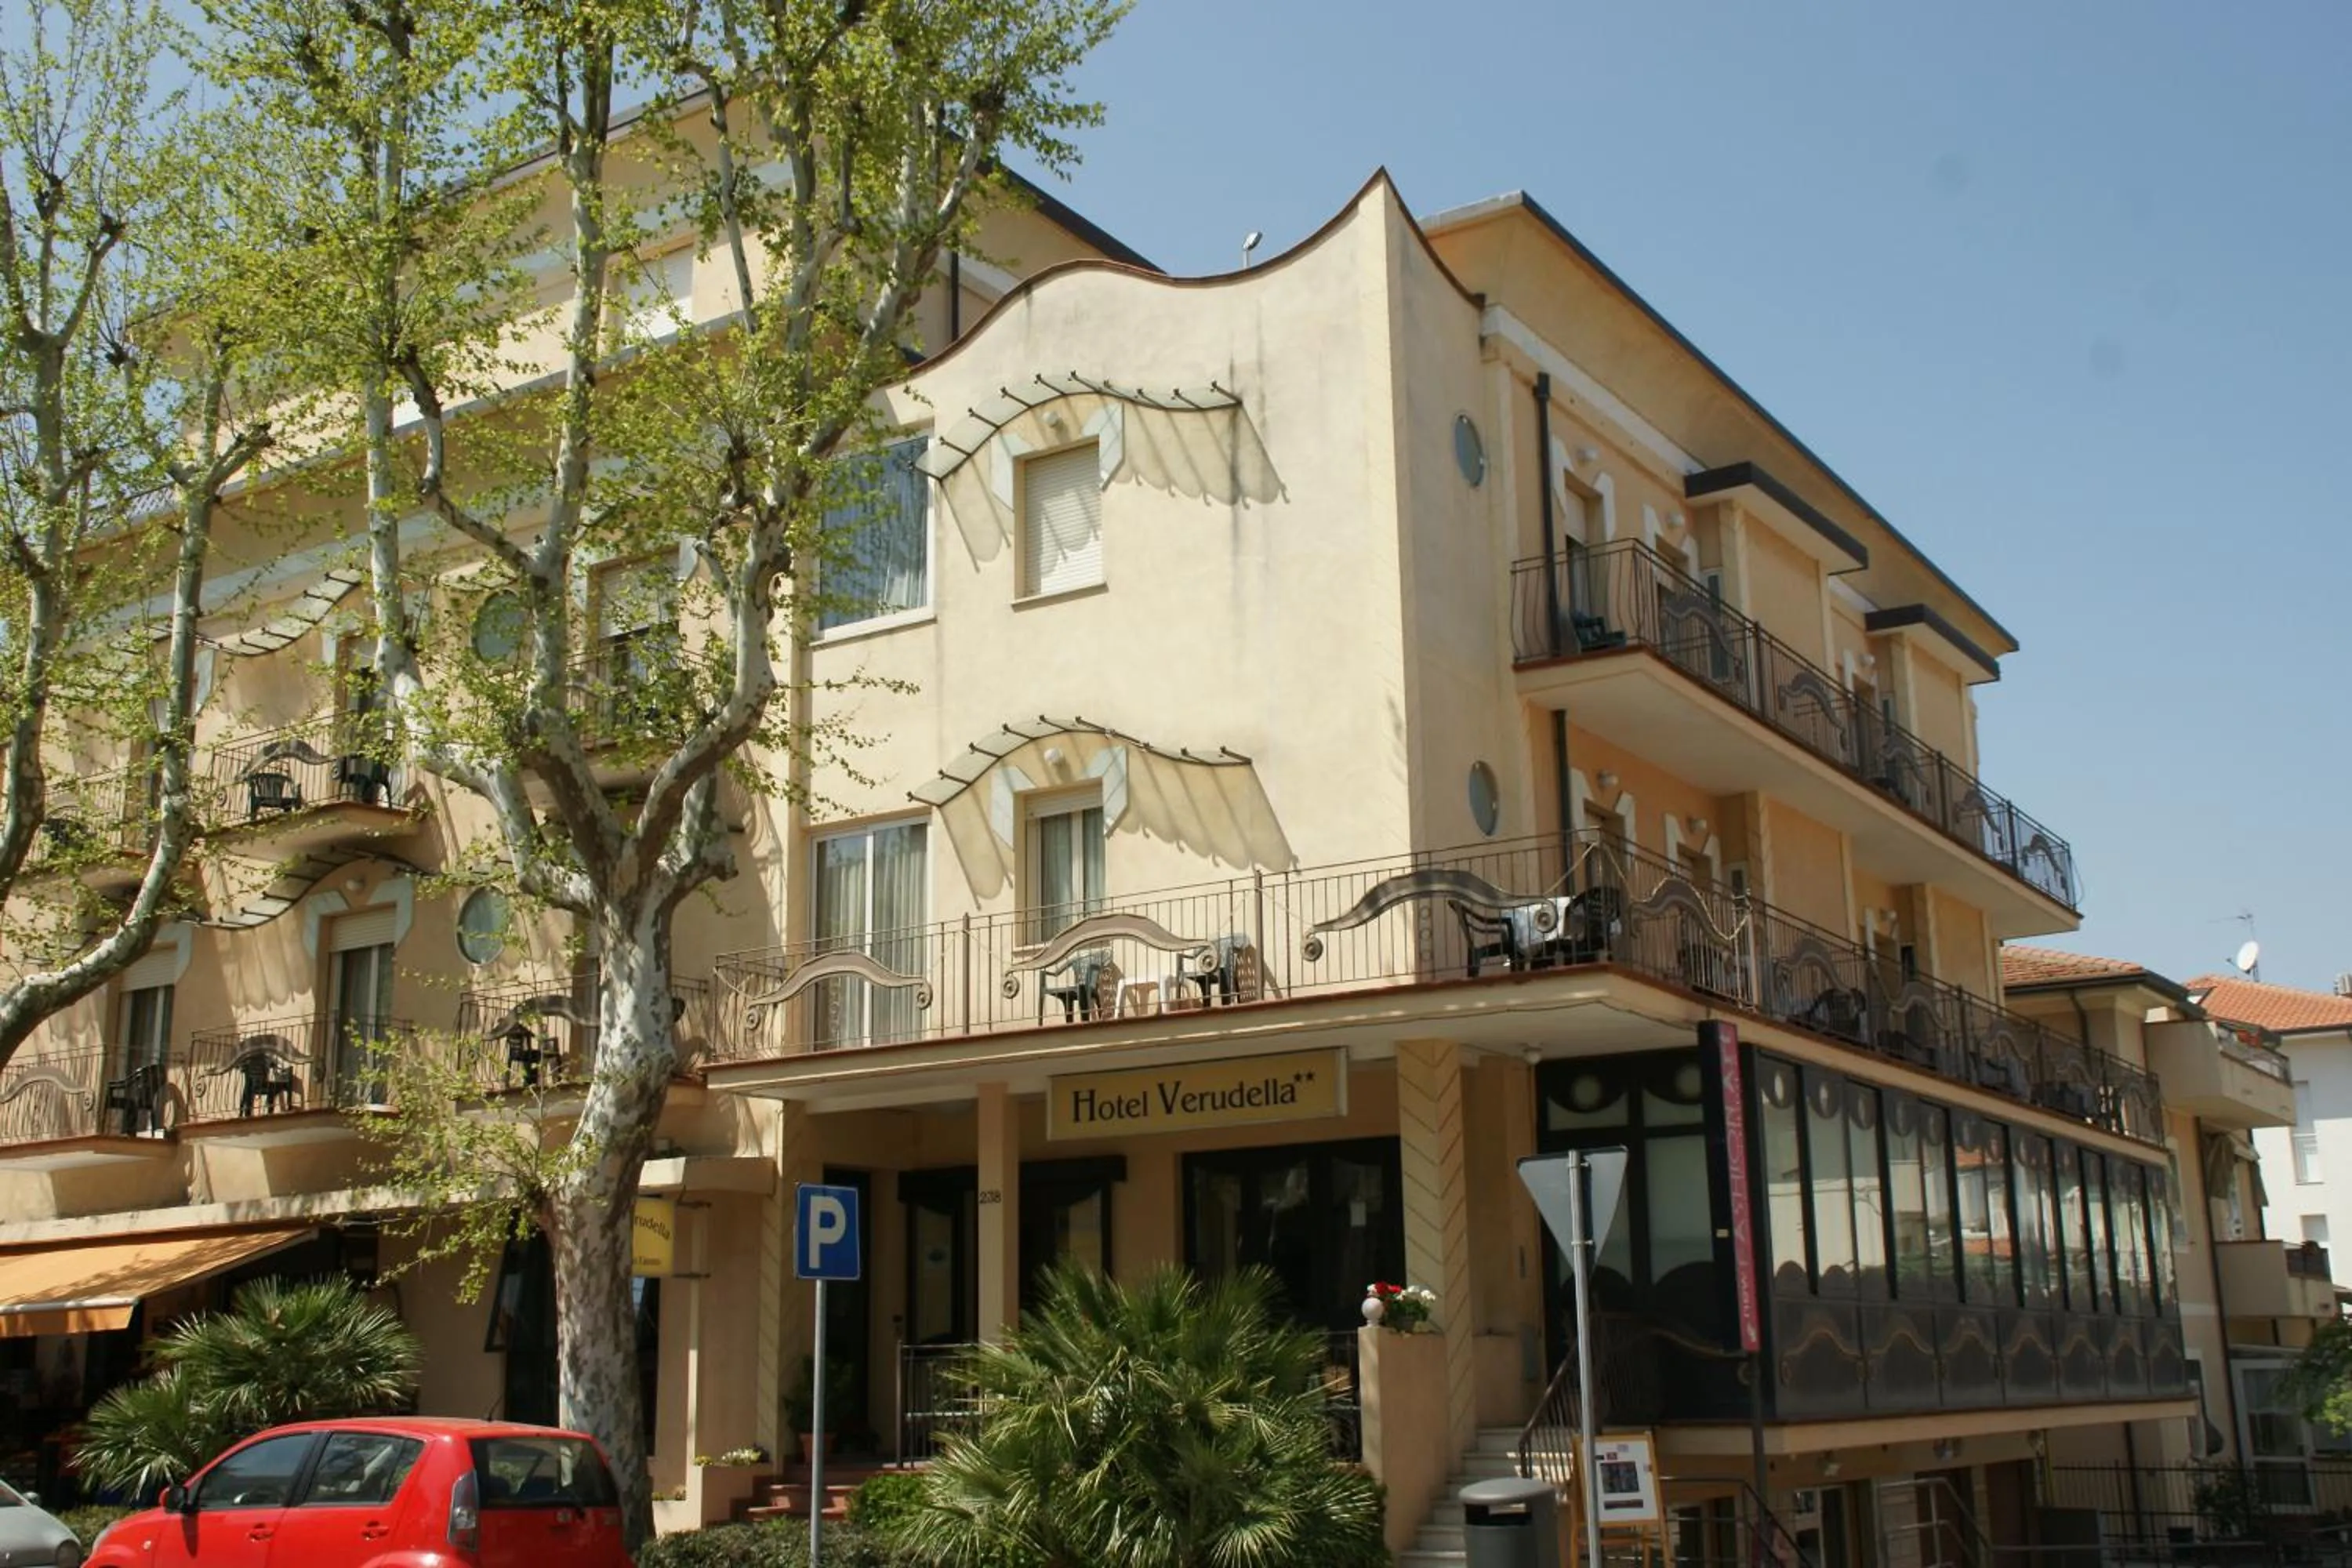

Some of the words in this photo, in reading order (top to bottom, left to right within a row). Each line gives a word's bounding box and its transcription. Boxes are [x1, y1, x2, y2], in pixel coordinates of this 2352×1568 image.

[1073, 1088, 1148, 1123] Hotel
[1157, 1079, 1298, 1114] Verudella
[634, 1216, 670, 1240] rudella
[809, 1195, 846, 1269] P
